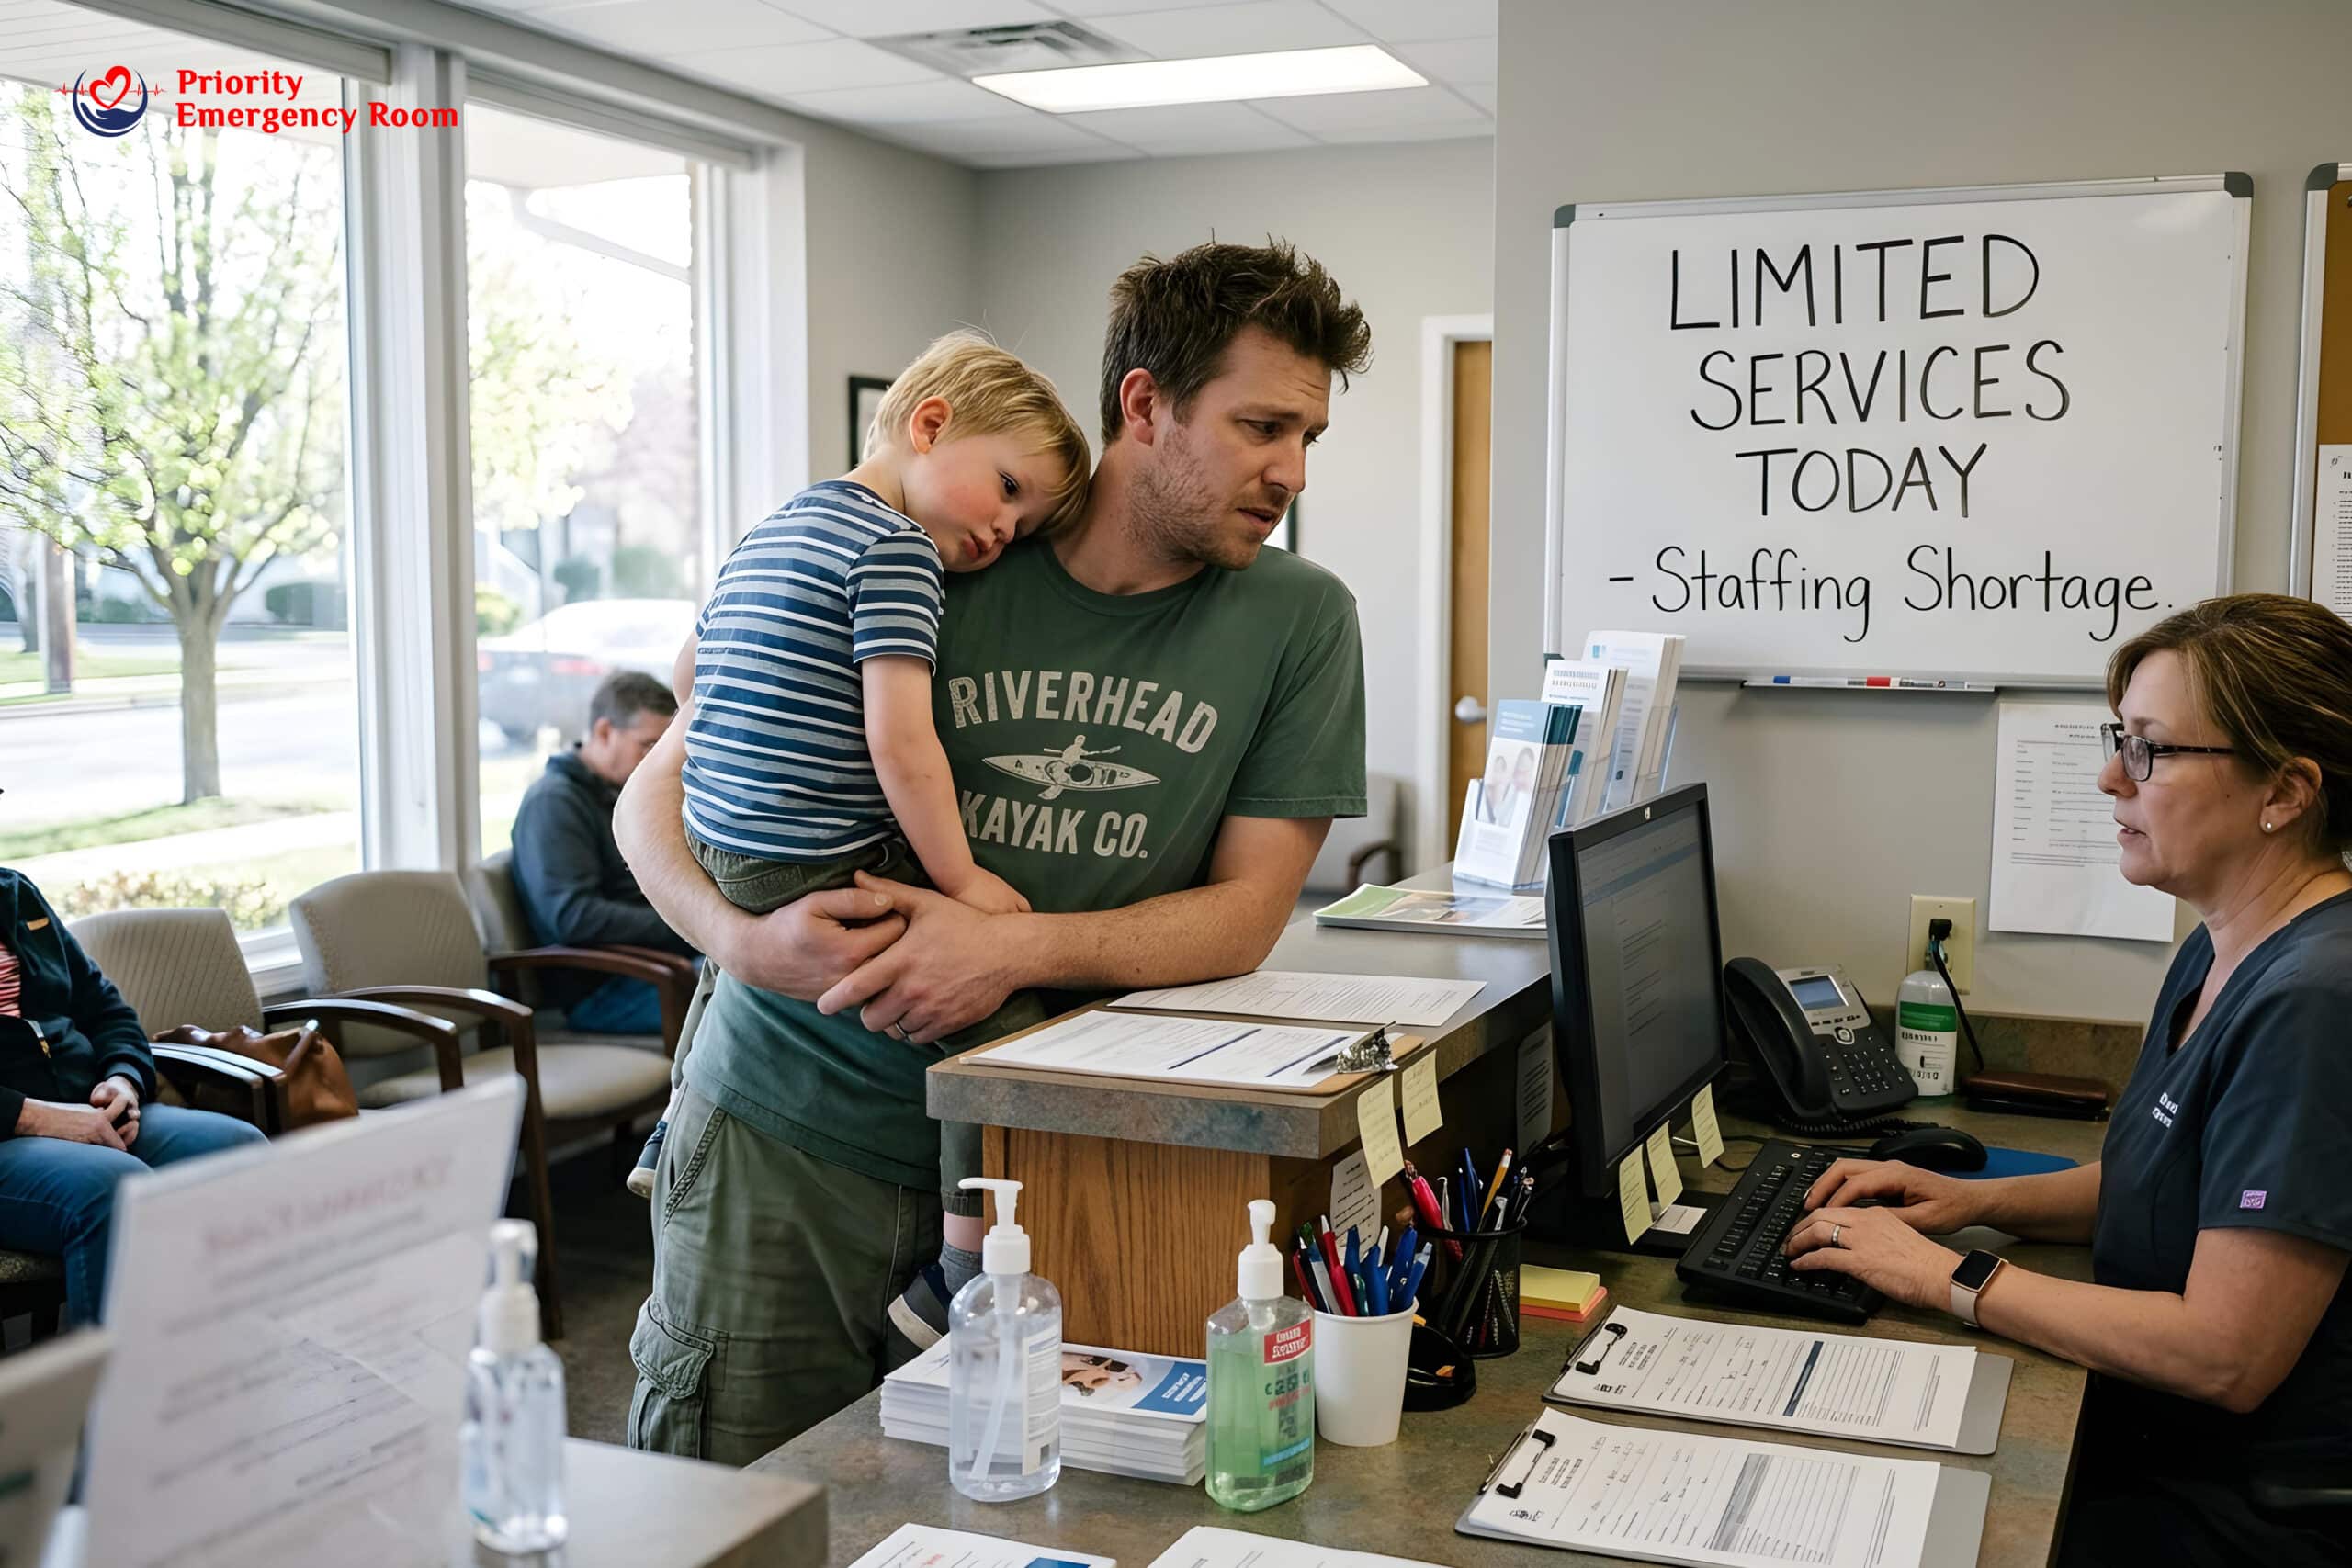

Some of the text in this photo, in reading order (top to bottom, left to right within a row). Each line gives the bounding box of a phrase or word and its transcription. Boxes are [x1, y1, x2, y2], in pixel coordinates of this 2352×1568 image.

[1669, 233, 2040, 331] LIMITED
[1690, 339, 2070, 431] SERVICES
[1735, 442, 1988, 518] TODAY
[1652, 546, 1871, 643] Staffing
[948, 670, 1219, 754] RIVERHEAD
[961, 790, 1148, 859] KAYAK CO.
